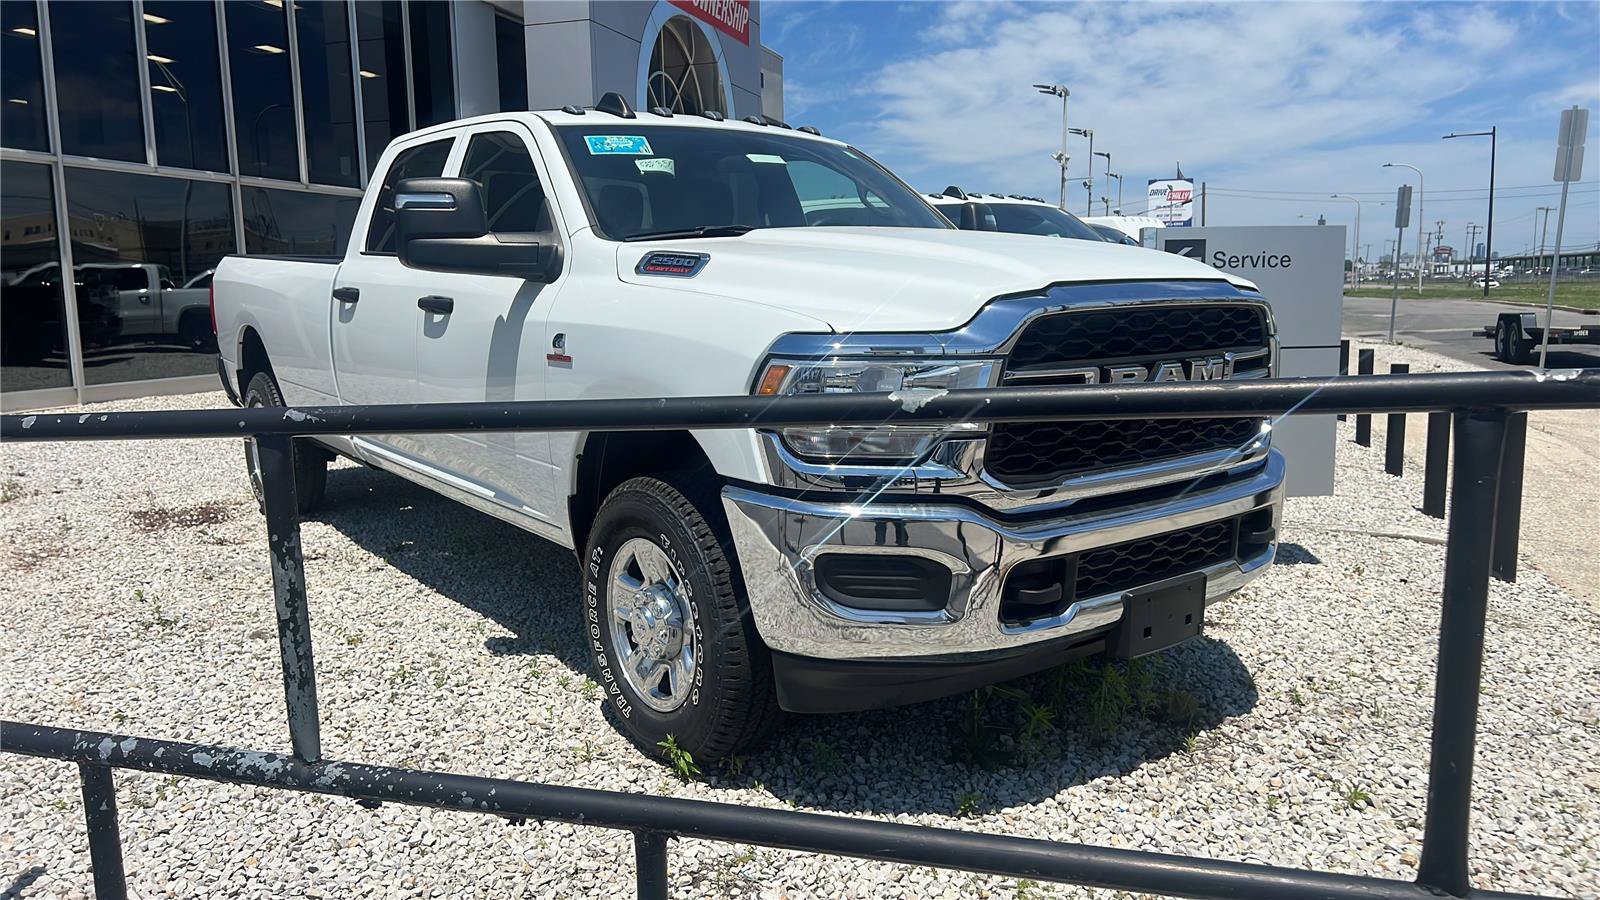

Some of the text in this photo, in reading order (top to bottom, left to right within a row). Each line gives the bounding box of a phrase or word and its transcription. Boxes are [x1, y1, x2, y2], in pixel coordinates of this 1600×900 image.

[692, 0, 749, 33] NERSHIP
[1149, 188, 1168, 197] DRIVE
[650, 256, 696, 267] 2500
[1212, 250, 1292, 269] Service
[588, 580, 633, 719] TRANSFORCE
